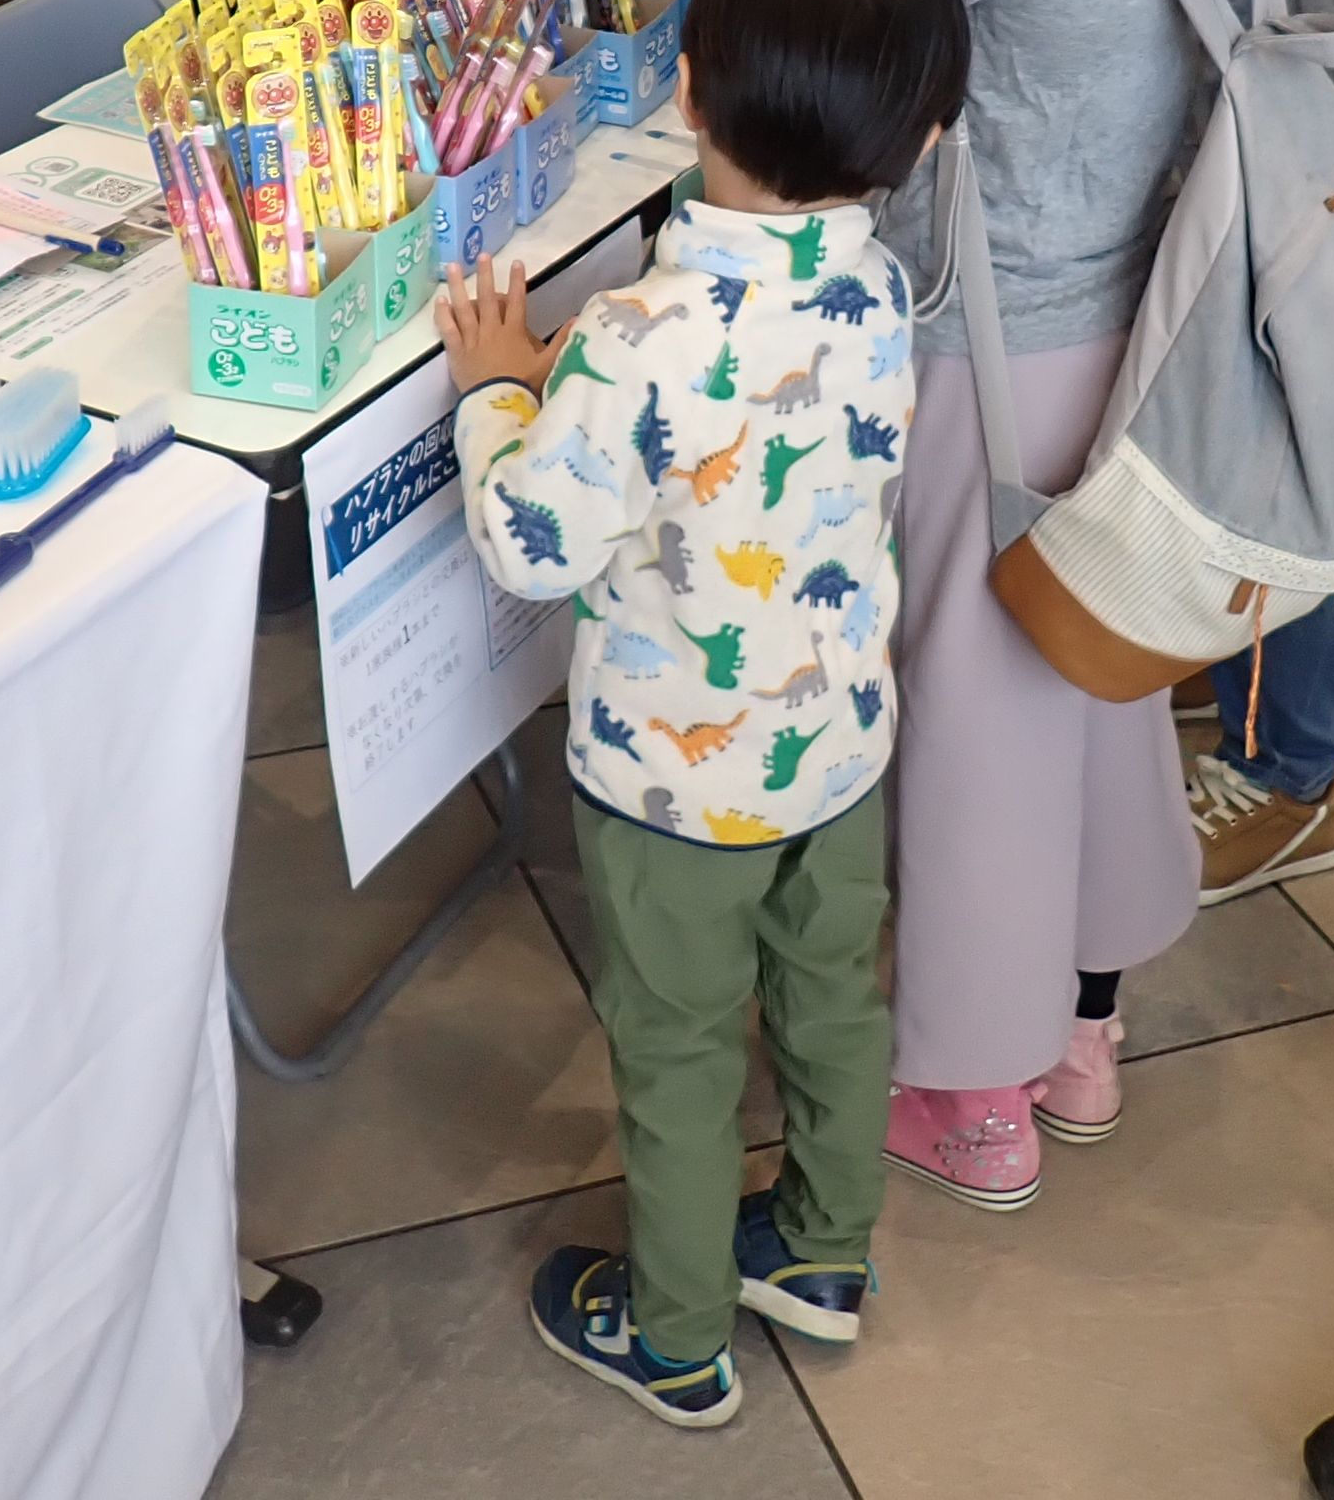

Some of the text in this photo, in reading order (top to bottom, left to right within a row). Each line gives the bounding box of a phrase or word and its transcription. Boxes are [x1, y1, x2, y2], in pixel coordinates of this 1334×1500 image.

[537, 121, 571, 171] こども
[471, 172, 512, 223] こども
[209, 316, 300, 356] こども
[217, 304, 272, 319] ライオン
[328, 282, 368, 344] こども
